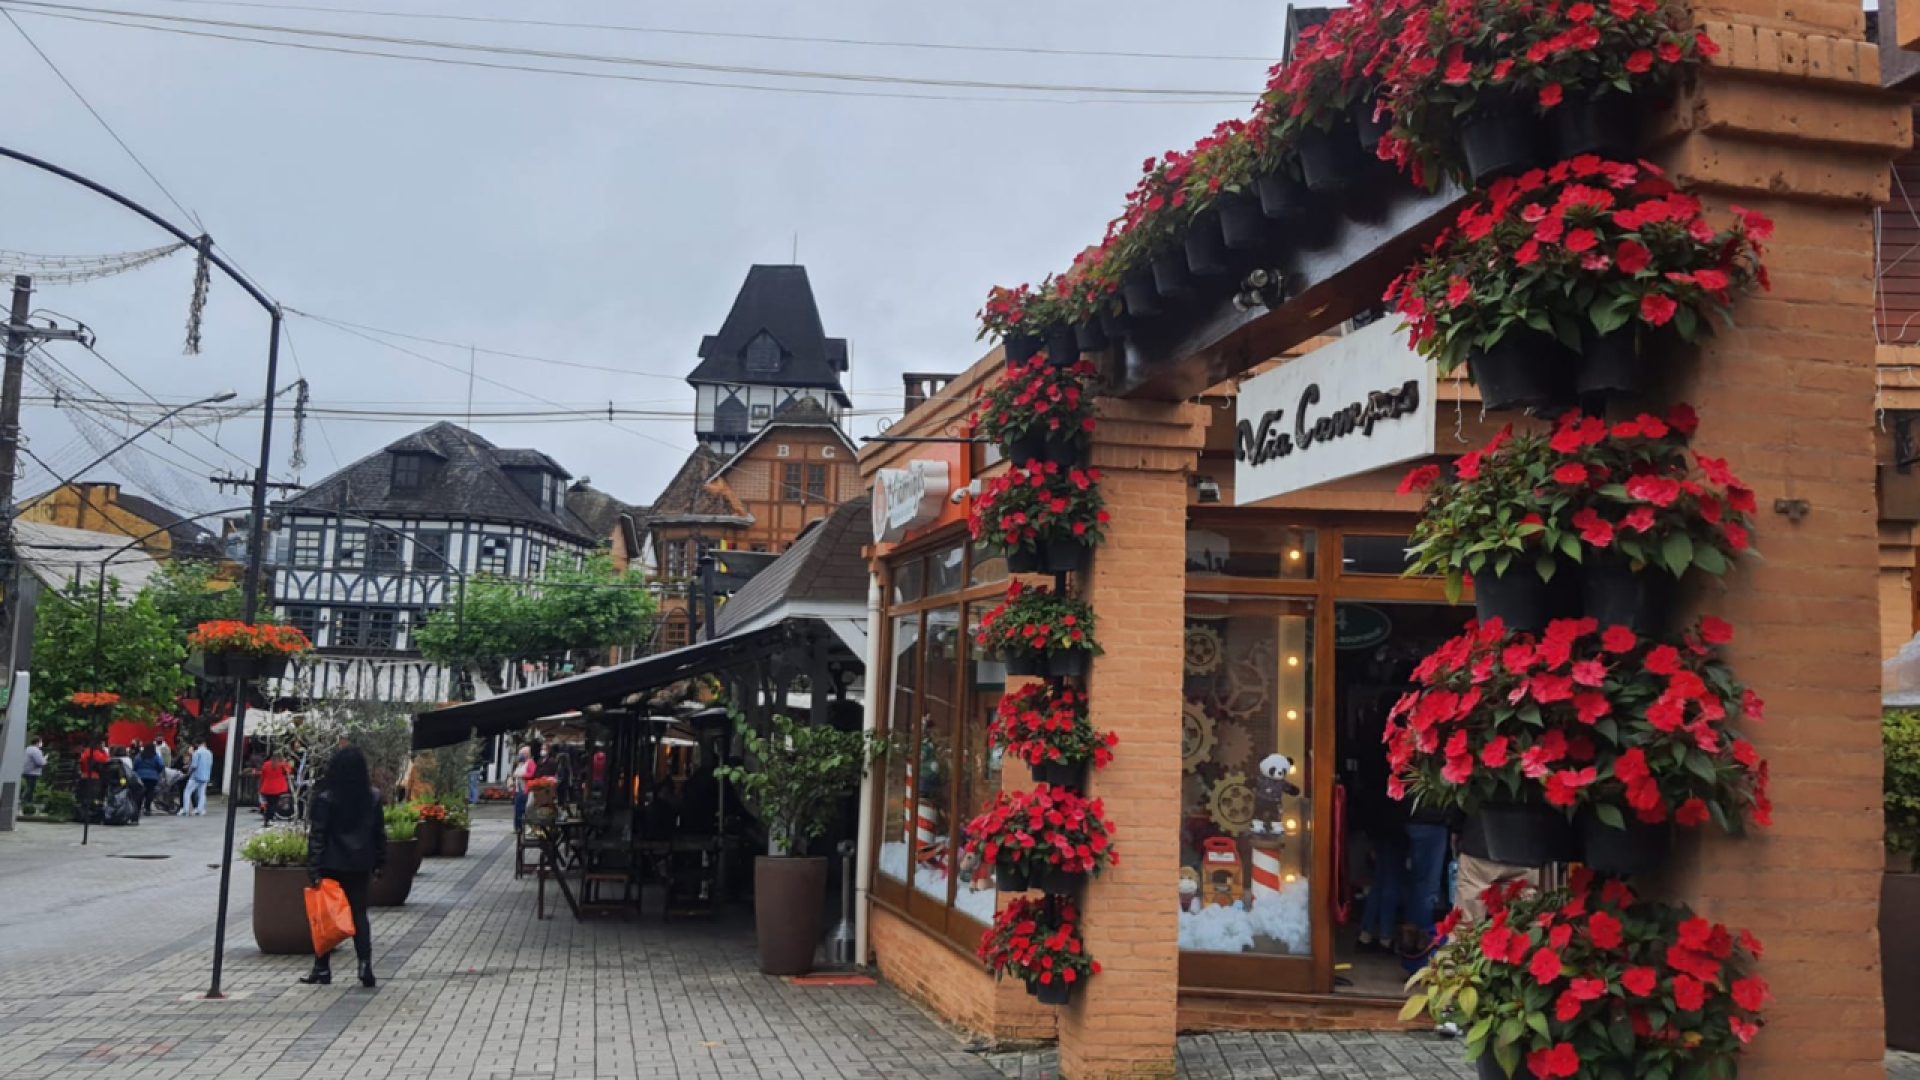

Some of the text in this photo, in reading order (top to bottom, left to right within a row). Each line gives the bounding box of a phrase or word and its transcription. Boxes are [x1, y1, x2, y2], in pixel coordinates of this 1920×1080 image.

[776, 444, 836, 459] B G
[1236, 409, 1294, 466] Via
